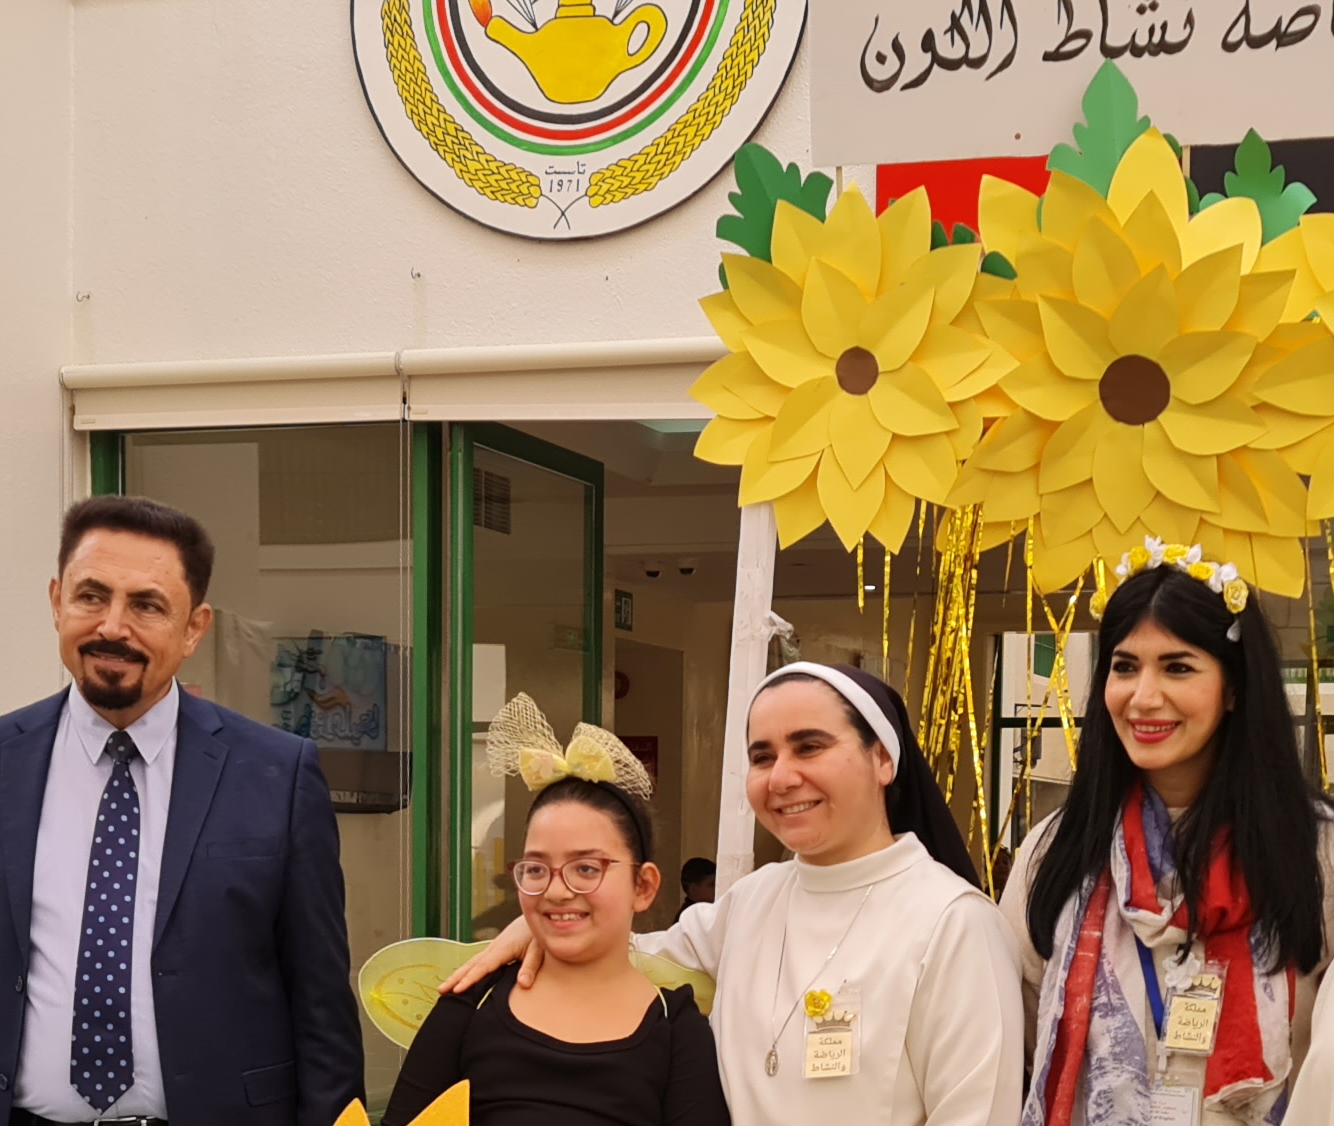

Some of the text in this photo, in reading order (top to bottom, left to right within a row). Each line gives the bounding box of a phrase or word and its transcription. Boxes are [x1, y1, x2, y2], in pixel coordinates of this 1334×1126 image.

[549, 179, 580, 193] 1971
[1184, 1002, 1207, 1013] مملكة
[1177, 1017, 1209, 1029] الرياضة
[818, 1037, 842, 1045] مملكة
[1173, 1031, 1207, 1044] والنشاط
[813, 1049, 846, 1060] الرياضة
[811, 1062, 846, 1072] والنشاط
